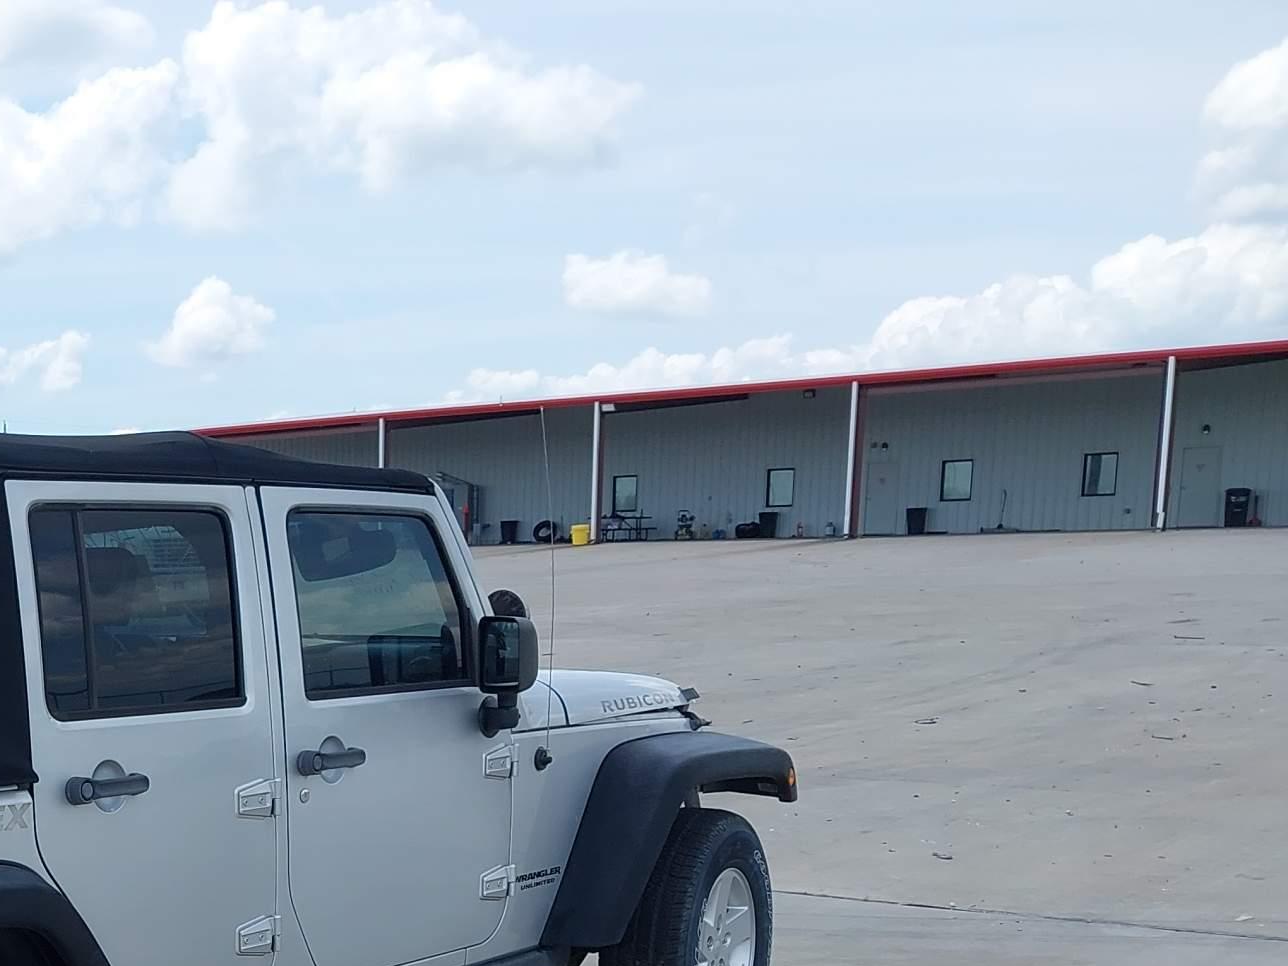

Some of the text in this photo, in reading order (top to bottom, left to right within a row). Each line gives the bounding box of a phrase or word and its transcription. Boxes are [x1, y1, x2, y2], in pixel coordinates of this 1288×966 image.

[600, 693, 676, 713] RUBICON
[515, 866, 561, 883] WRANGLER
[520, 877, 556, 891] UNLIMITED
